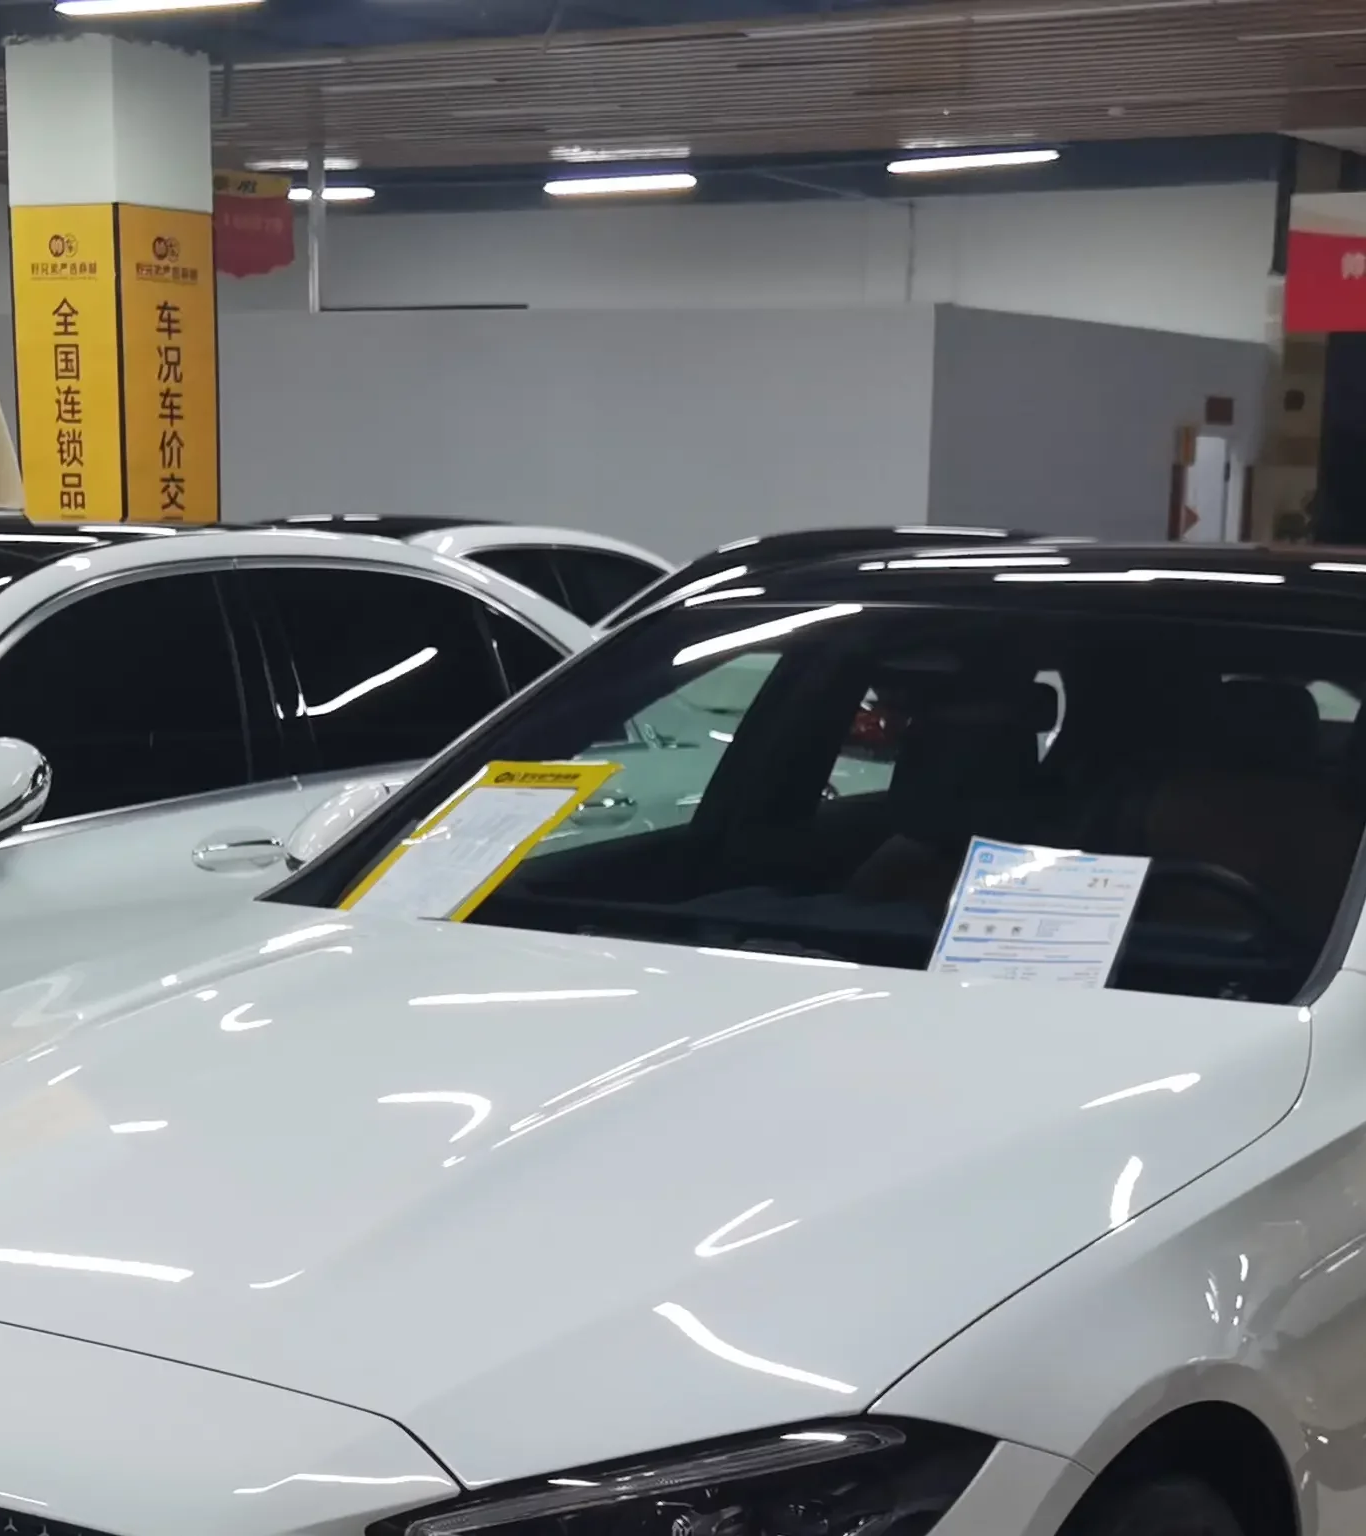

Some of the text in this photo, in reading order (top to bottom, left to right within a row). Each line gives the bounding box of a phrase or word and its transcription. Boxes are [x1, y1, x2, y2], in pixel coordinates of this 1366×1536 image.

[51, 297, 87, 519] 全国连锁品
[155, 300, 187, 522] 车况车价交
